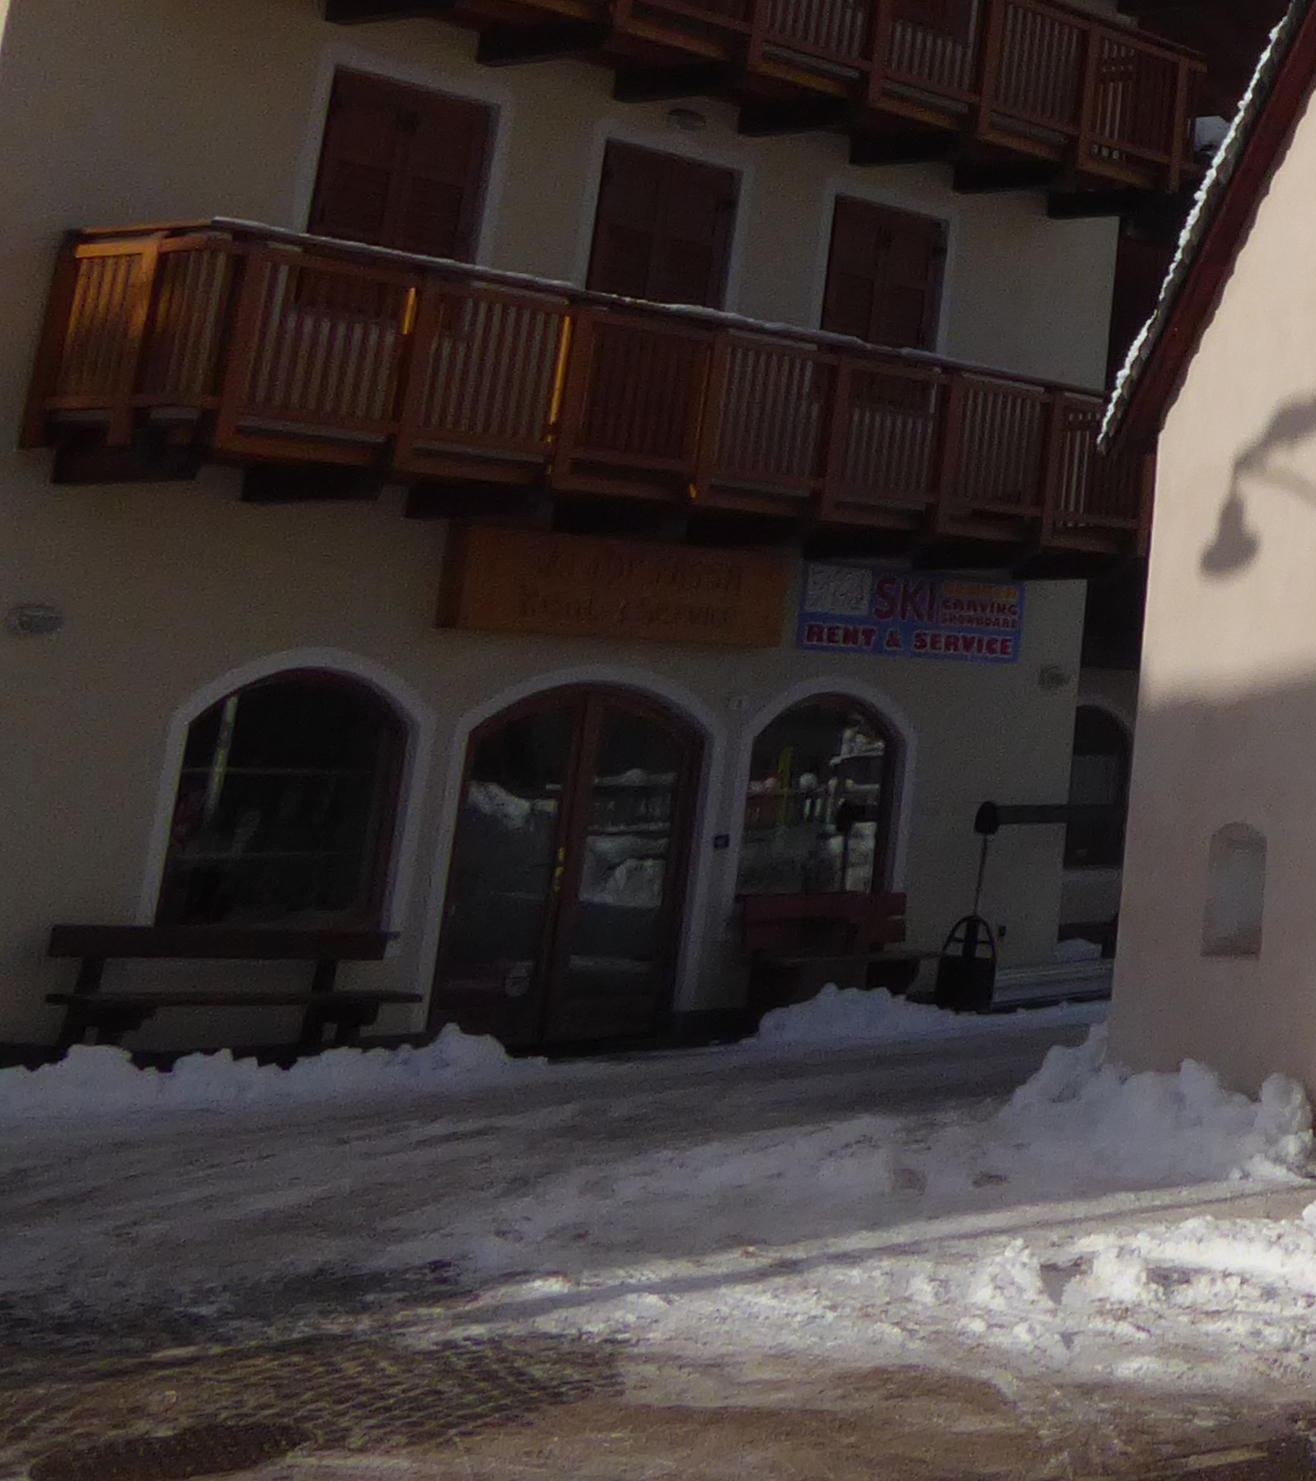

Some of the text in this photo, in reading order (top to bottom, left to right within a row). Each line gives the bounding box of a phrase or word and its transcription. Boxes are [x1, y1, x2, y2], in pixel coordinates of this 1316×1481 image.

[874, 577, 937, 622] SKI
[942, 598, 1018, 616] CARVING
[805, 623, 1013, 656] RENT & SERVICE
